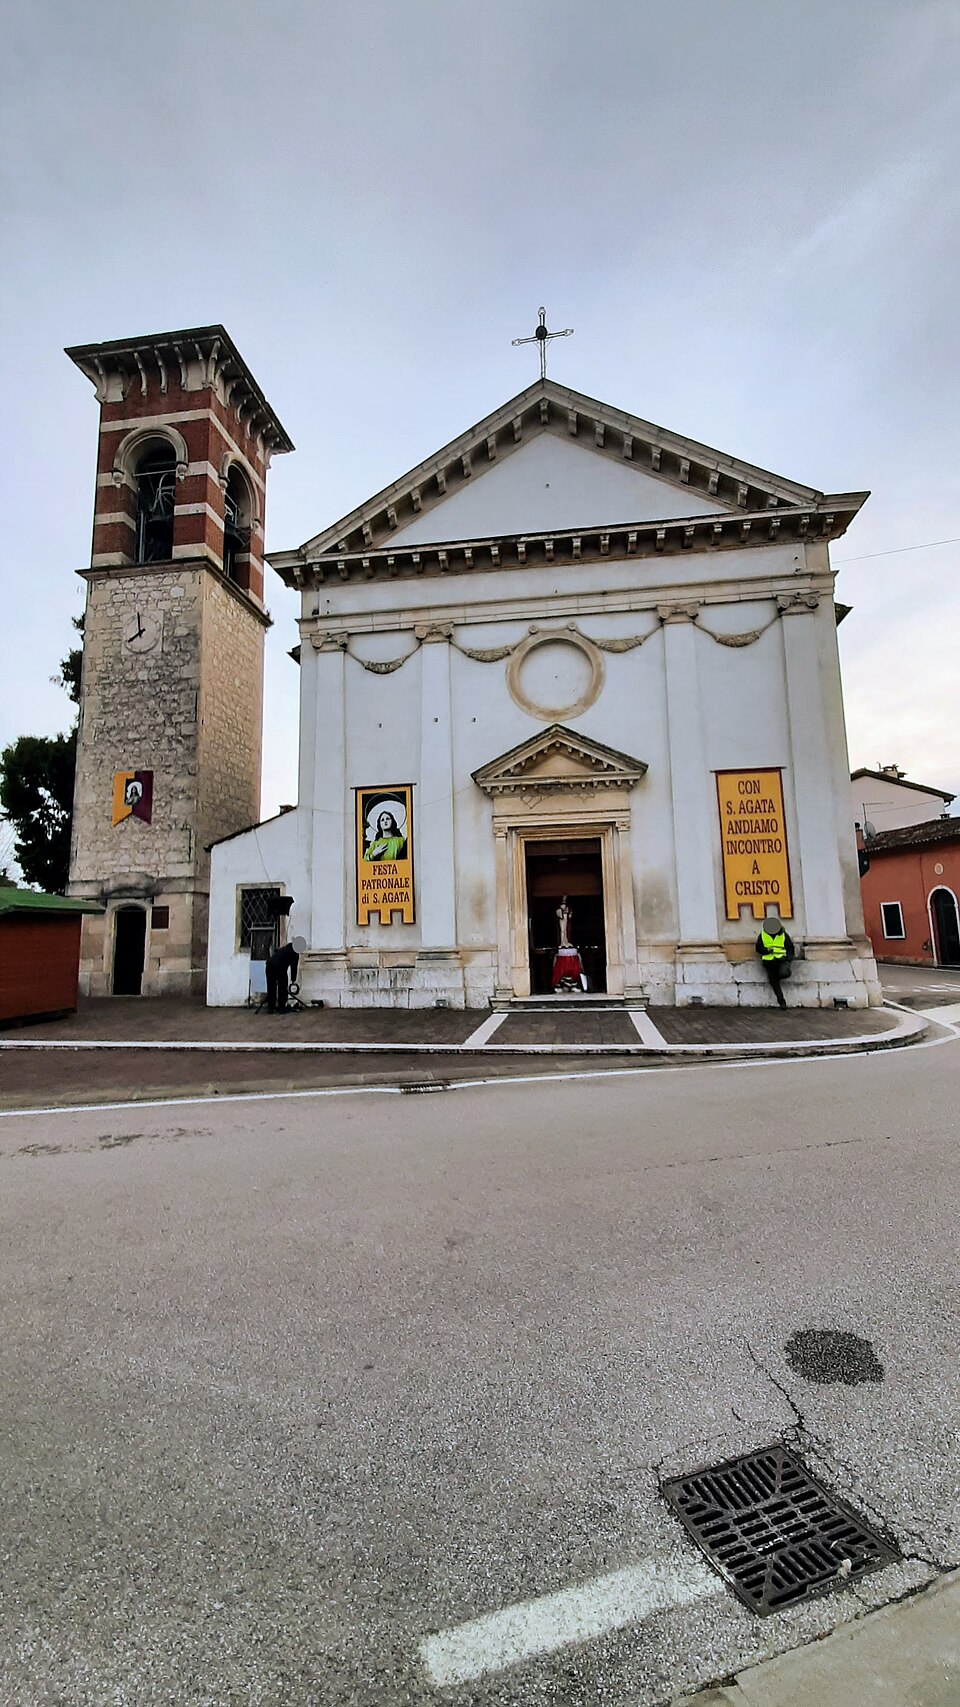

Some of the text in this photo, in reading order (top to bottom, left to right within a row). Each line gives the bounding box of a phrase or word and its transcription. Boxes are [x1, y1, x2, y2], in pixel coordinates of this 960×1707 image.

[738, 780, 760, 794] CON
[726, 799, 776, 815] S. AGATA
[727, 818, 778, 834] ANDIAMO
[726, 838, 782, 855] INCONTRO
[372, 864, 398, 876] FESTA
[752, 860, 760, 875] A
[362, 878, 410, 890] PATRONALE
[735, 880, 780, 896] CRISTO
[362, 892, 410, 904] di S. AGATA
